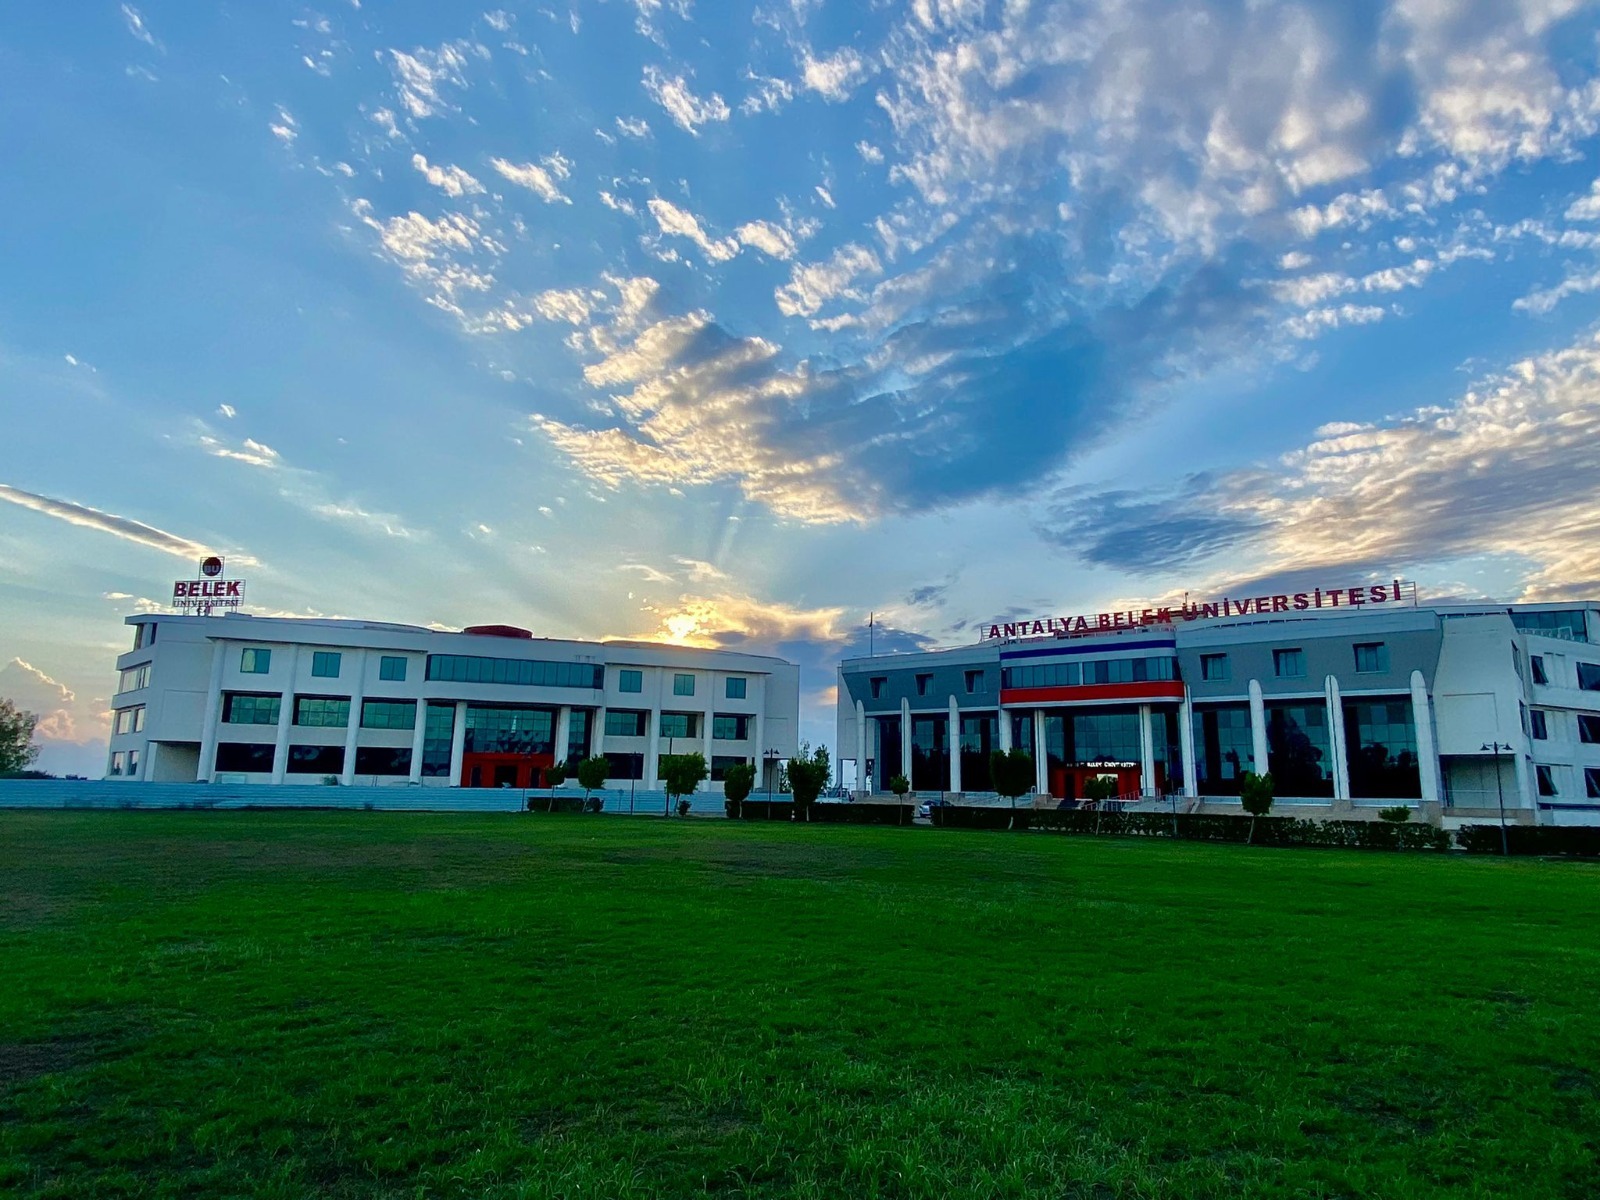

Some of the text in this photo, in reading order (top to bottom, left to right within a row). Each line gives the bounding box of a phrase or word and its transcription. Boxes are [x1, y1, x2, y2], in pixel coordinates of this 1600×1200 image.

[174, 581, 240, 596] BELEK
[989, 580, 1401, 638] ANTALYA BELEK ÜNİVERSİTESİ
